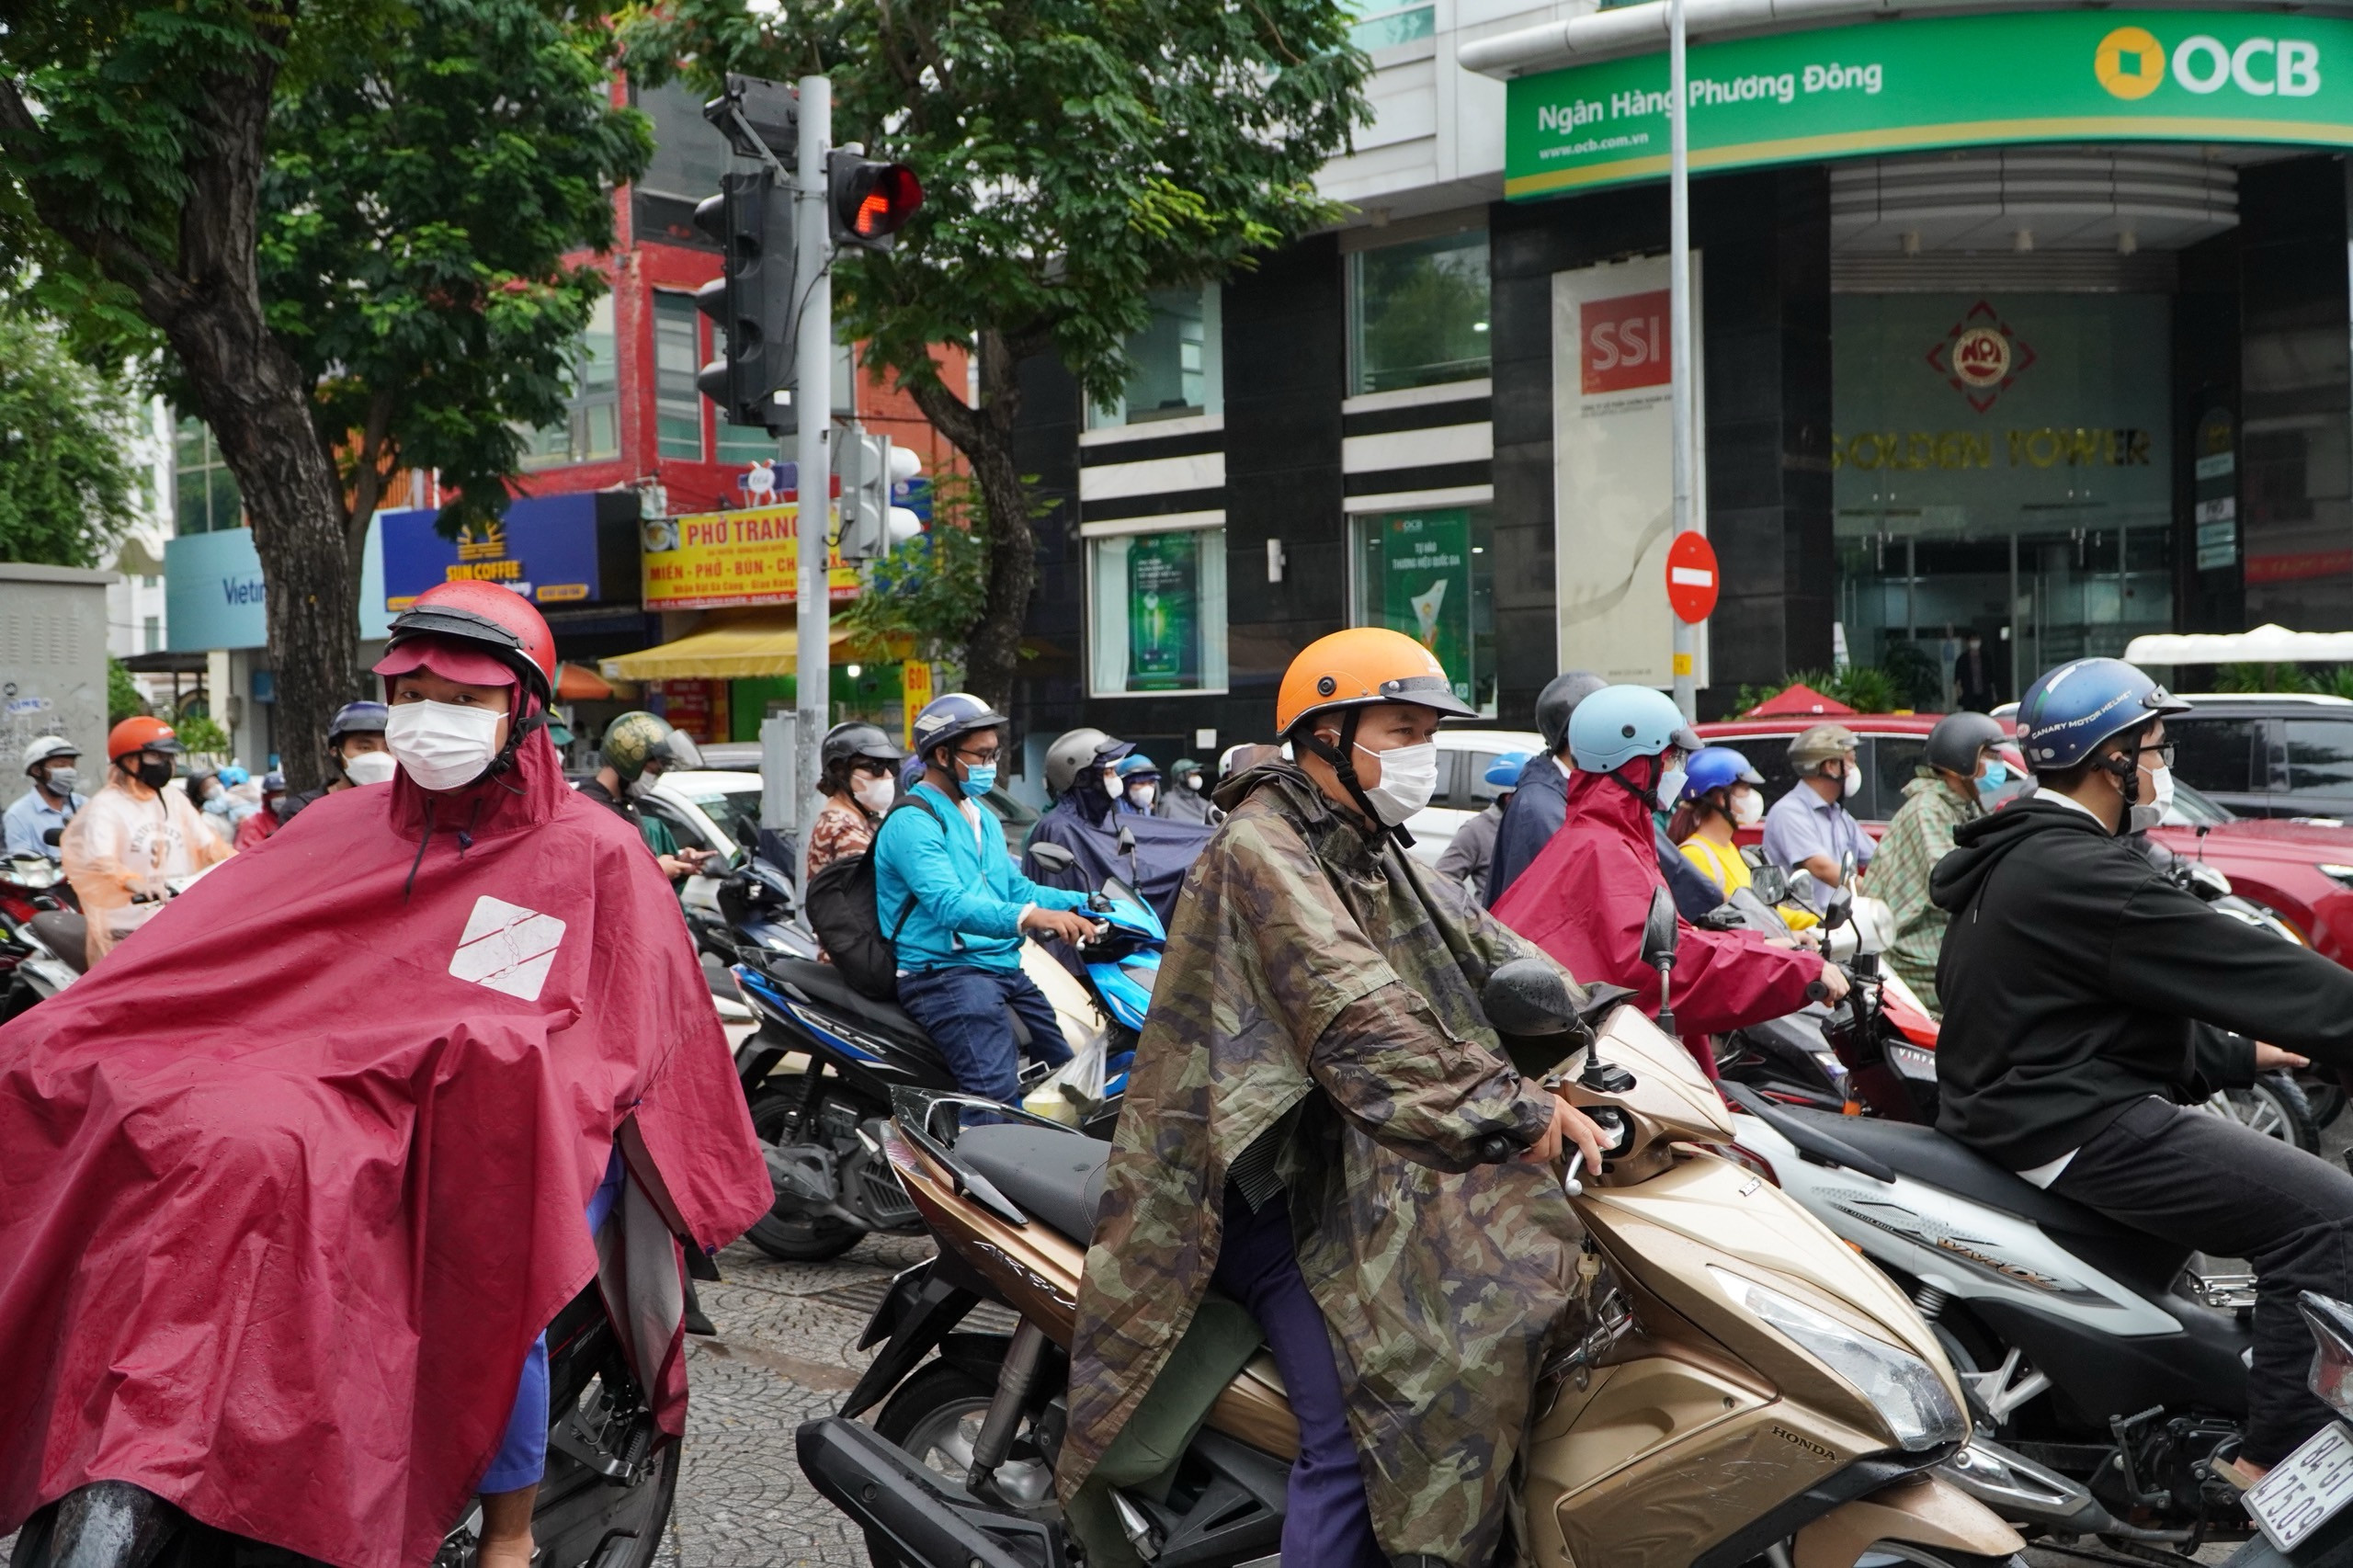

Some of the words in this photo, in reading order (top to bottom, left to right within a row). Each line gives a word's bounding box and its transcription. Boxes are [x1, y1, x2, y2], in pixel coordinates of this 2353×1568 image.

[2171, 34, 2322, 97] OCB
[1538, 98, 1604, 134] Ngân
[1688, 74, 1795, 108] Phương
[1802, 62, 1883, 95] Đông
[1538, 131, 1649, 161] www.ocb.com.vn
[1590, 315, 1660, 371] SSI
[2006, 427, 2152, 468] TOWER
[687, 516, 729, 546] PHỞ
[446, 565, 472, 582] SUN
[473, 561, 521, 581] COFFEE
[2031, 722, 2067, 740] CANARY
[2068, 710, 2102, 729] MOTOR
[2100, 689, 2132, 713] HELMET
[1771, 1425, 1837, 1461] HONDA
[2253, 1467, 2325, 1540] 475.09
